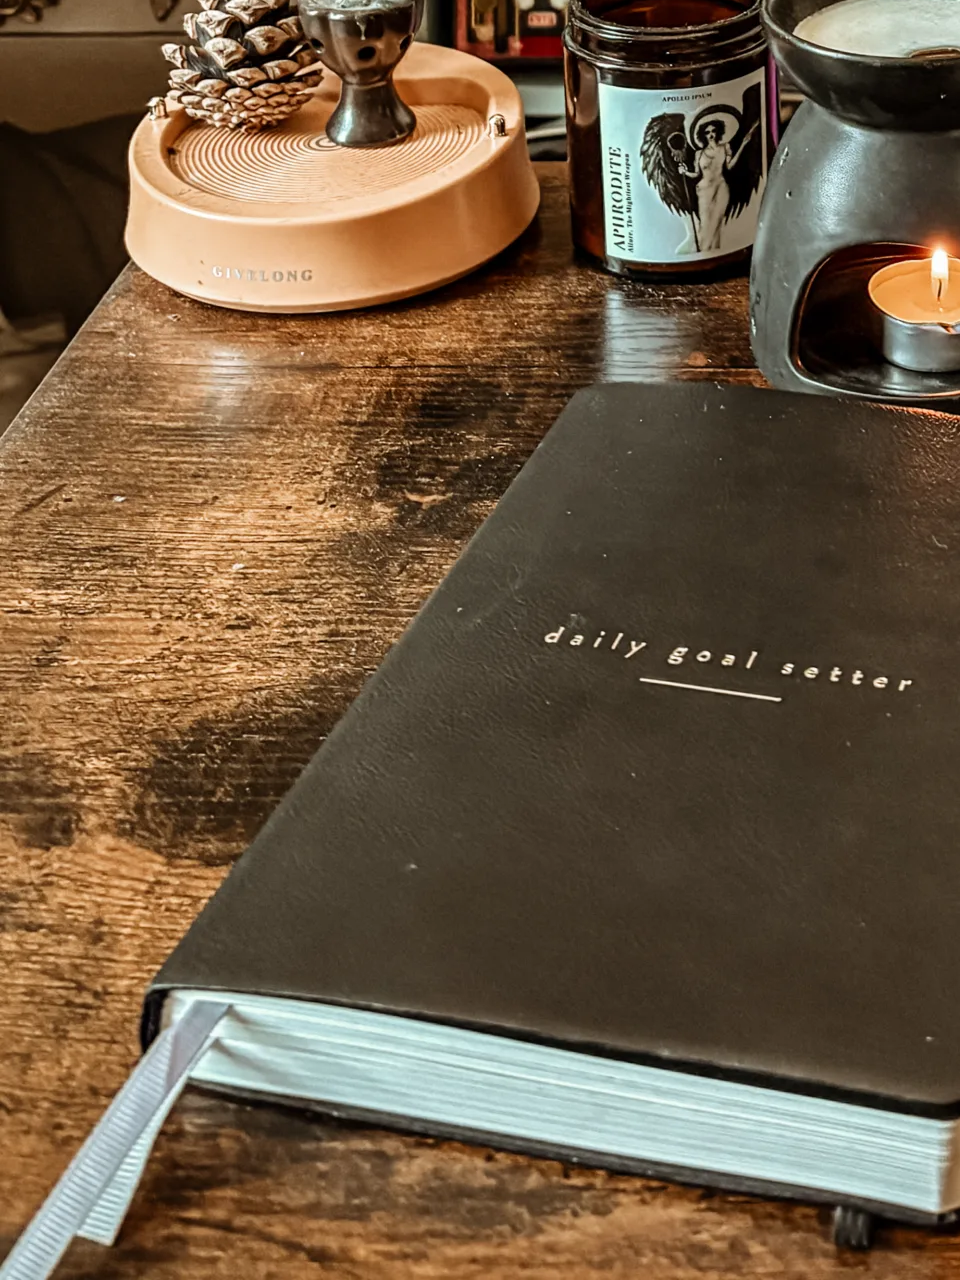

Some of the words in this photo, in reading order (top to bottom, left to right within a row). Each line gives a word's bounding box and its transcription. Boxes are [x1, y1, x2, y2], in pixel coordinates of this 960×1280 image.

[608, 146, 626, 251] APHRODITE
[545, 627, 647, 659] daily
[667, 646, 758, 670] goal
[781, 661, 912, 691] setter
